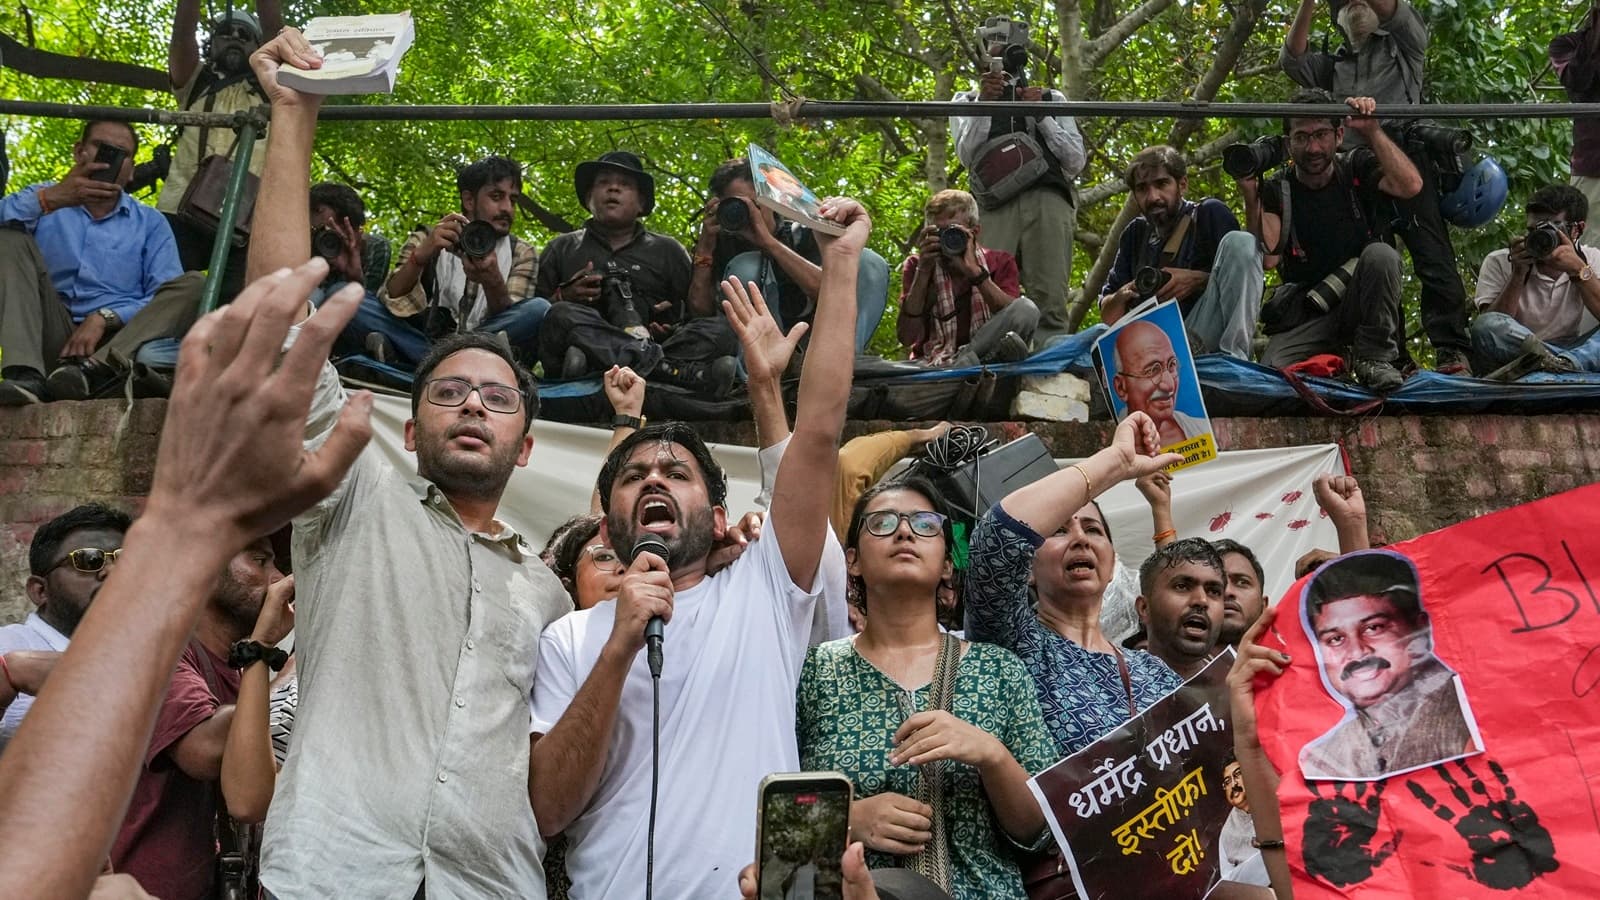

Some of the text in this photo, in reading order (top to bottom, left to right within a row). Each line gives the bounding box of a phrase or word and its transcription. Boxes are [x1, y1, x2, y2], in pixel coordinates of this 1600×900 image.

[1069, 702, 1225, 818] धर्मेंद्र प्रधान,
[1111, 766, 1208, 855] इस्तीफ़ा
[1166, 829, 1206, 876] दो!
